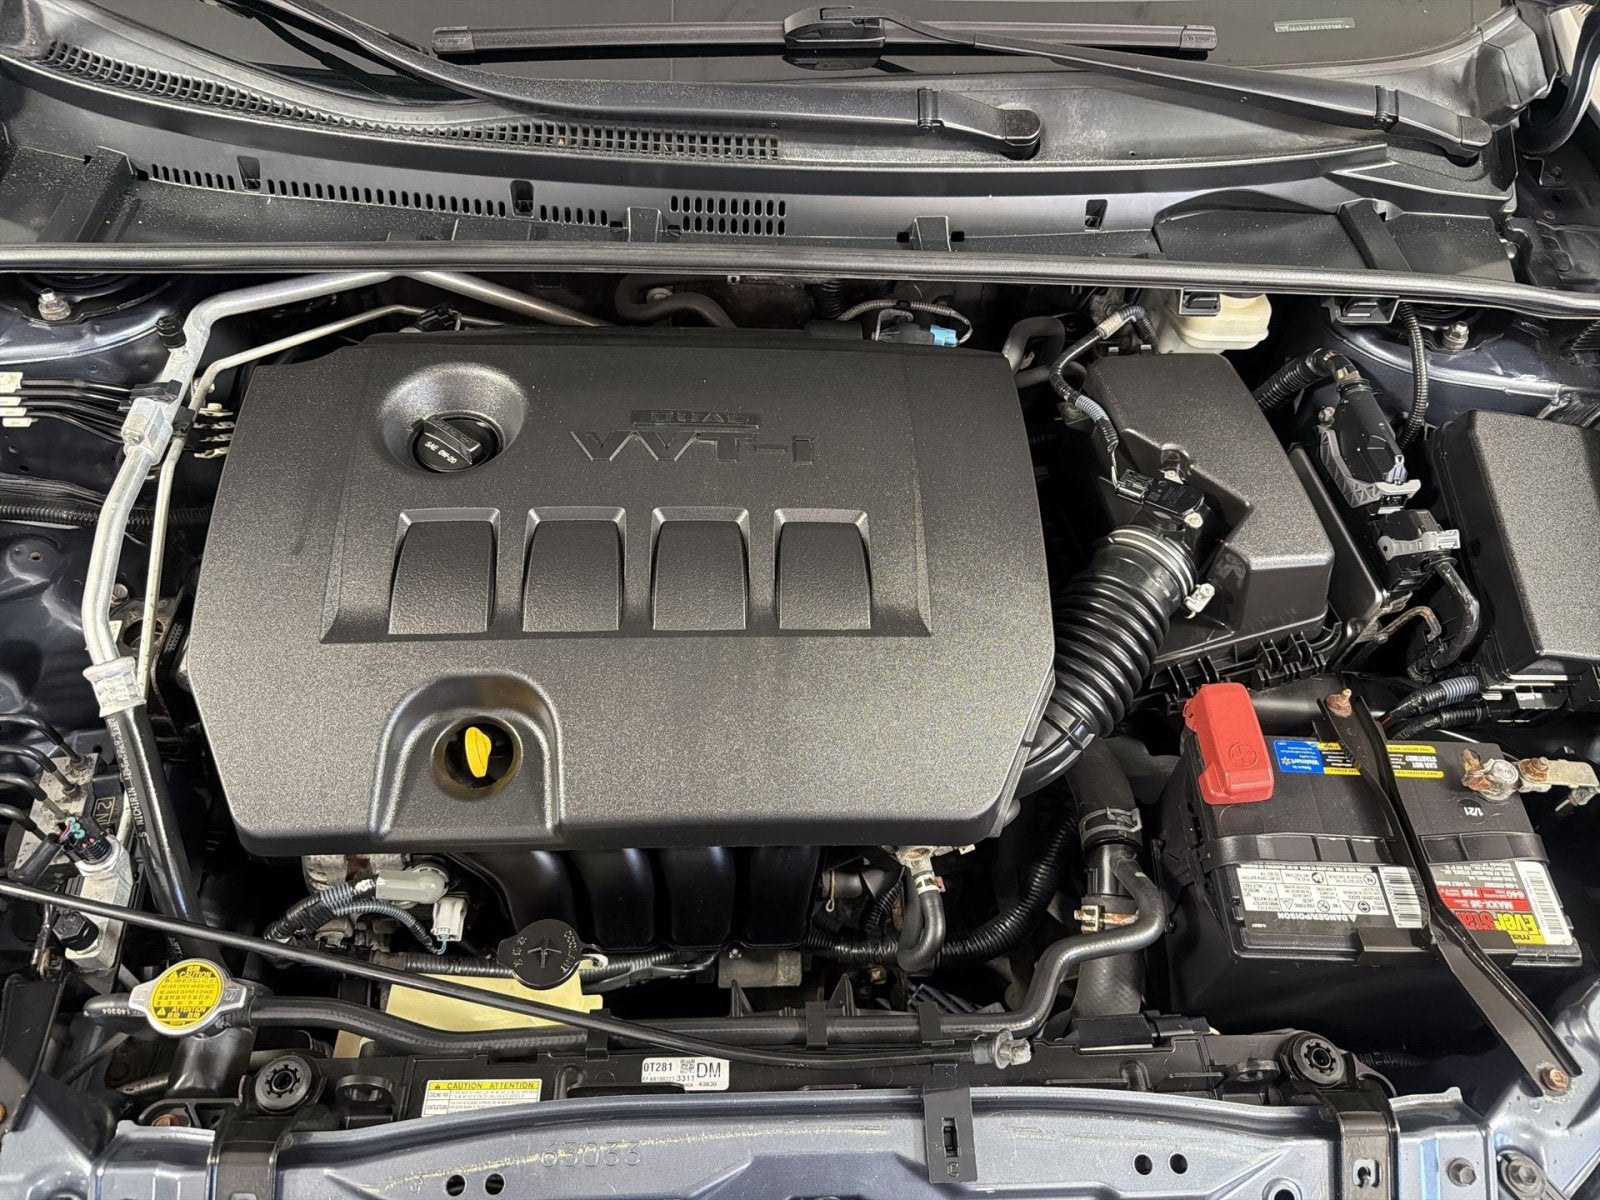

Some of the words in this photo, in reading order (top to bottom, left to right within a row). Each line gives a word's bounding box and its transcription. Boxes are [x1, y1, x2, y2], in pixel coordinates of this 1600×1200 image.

[651, 411, 750, 423] DUAL
[425, 442, 439, 451] SAE
[438, 450, 457, 463] 0W-20
[128, 788, 144, 826] NICHIRIN
[1463, 807, 1483, 817] 1/21
[1455, 911, 1540, 935] EverSta
[697, 1062, 720, 1078] DM
